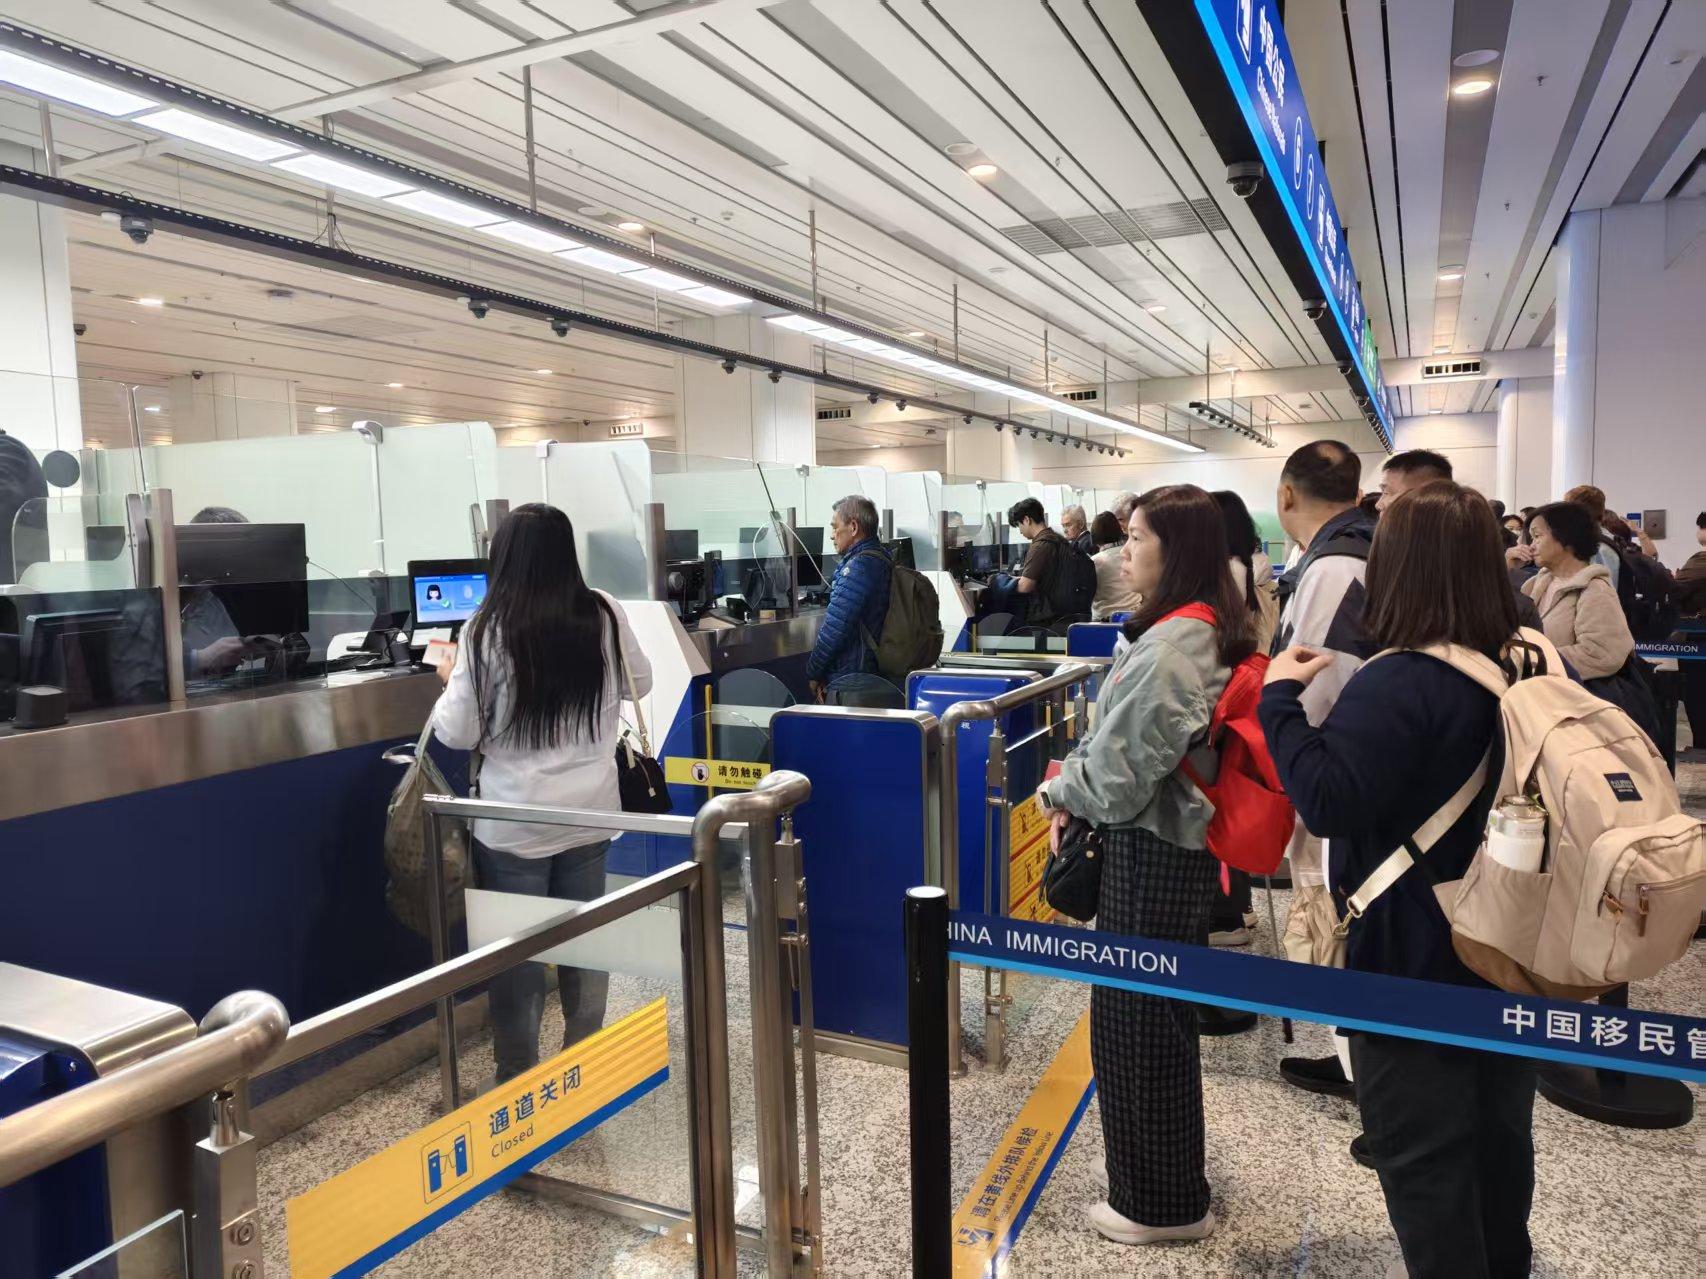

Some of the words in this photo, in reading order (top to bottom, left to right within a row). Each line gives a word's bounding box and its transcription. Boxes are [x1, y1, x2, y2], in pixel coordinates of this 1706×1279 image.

[1634, 643, 1698, 653] MMIGRATION
[718, 765, 763, 779] 请勿触碰
[1006, 929, 1178, 976] IMMIGRATION
[488, 1064, 581, 1138] 通道关闭
[491, 1123, 535, 1158] Closed
